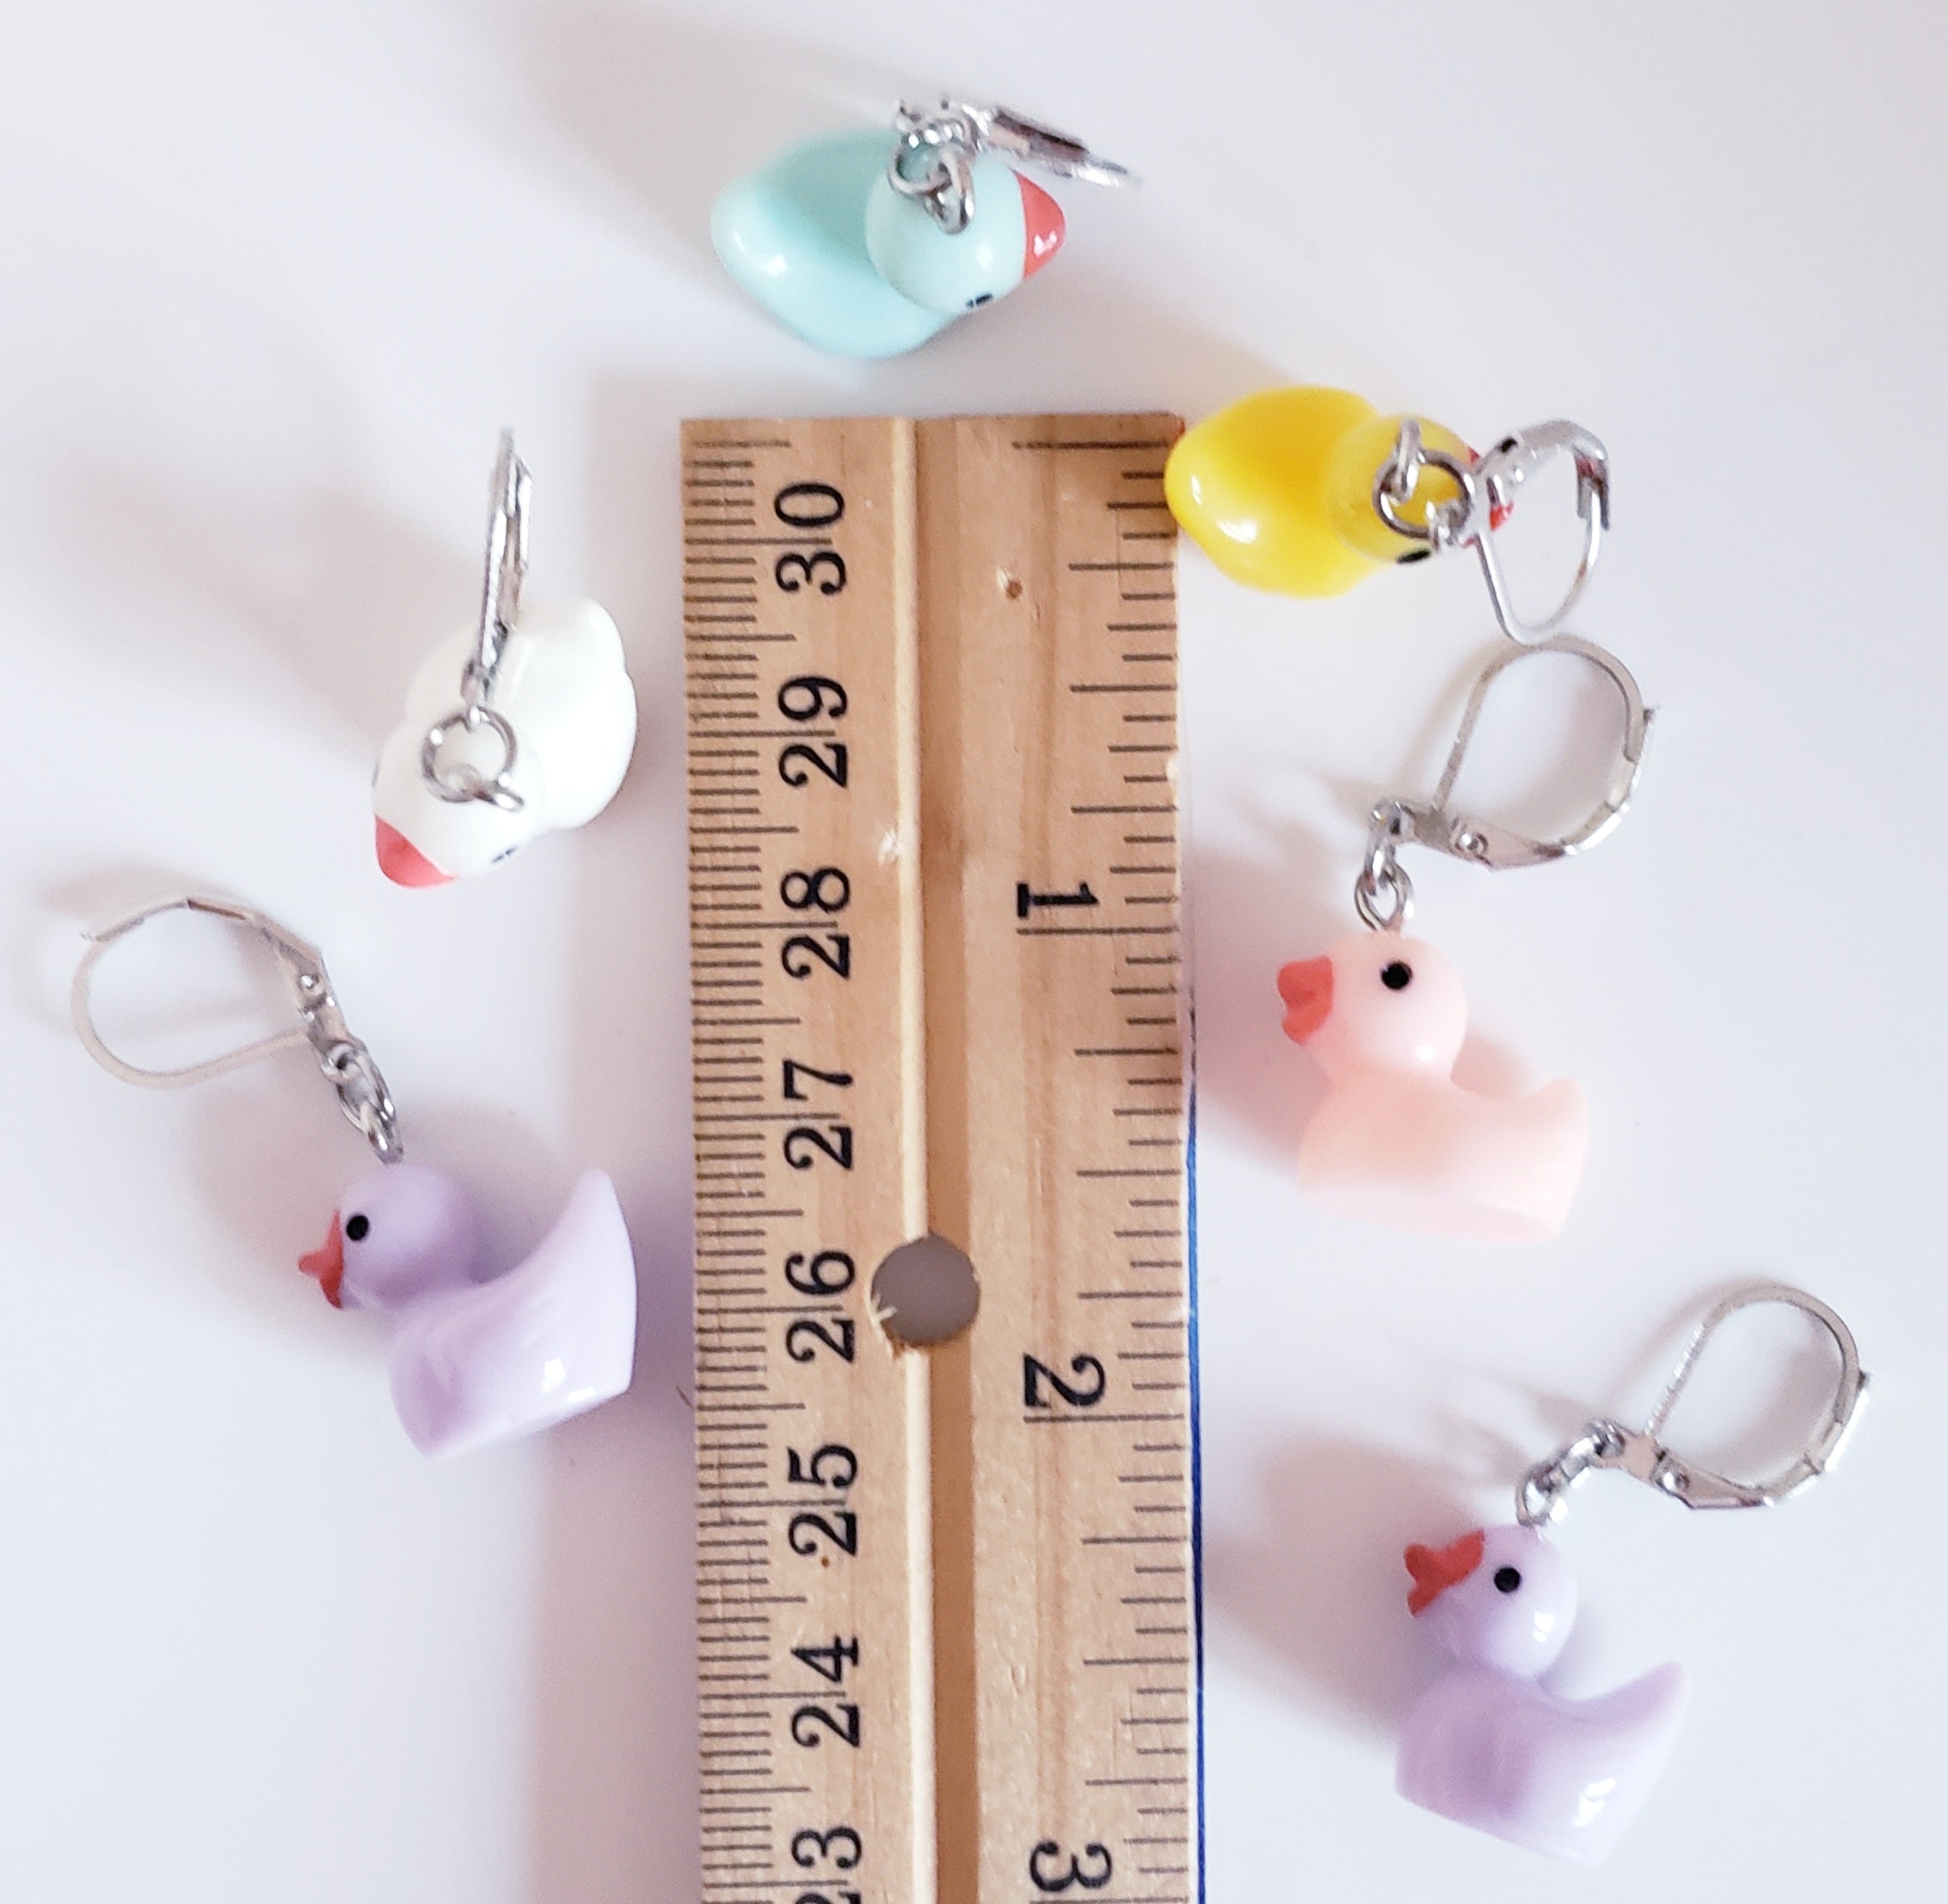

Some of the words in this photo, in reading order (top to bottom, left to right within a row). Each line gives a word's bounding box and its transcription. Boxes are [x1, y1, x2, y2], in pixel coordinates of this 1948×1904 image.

[773, 482, 847, 596] 30
[777, 675, 849, 789] 29
[779, 867, 851, 980] 28
[1016, 881, 1099, 918] 1
[783, 1059, 854, 1170] 27
[784, 1250, 857, 1364] 26
[1023, 1354, 1106, 1409] 2
[788, 1443, 858, 1557] 25
[790, 1635, 861, 1748] 24
[790, 1826, 862, 1904] 3
[1029, 1840, 1113, 1893] 3
